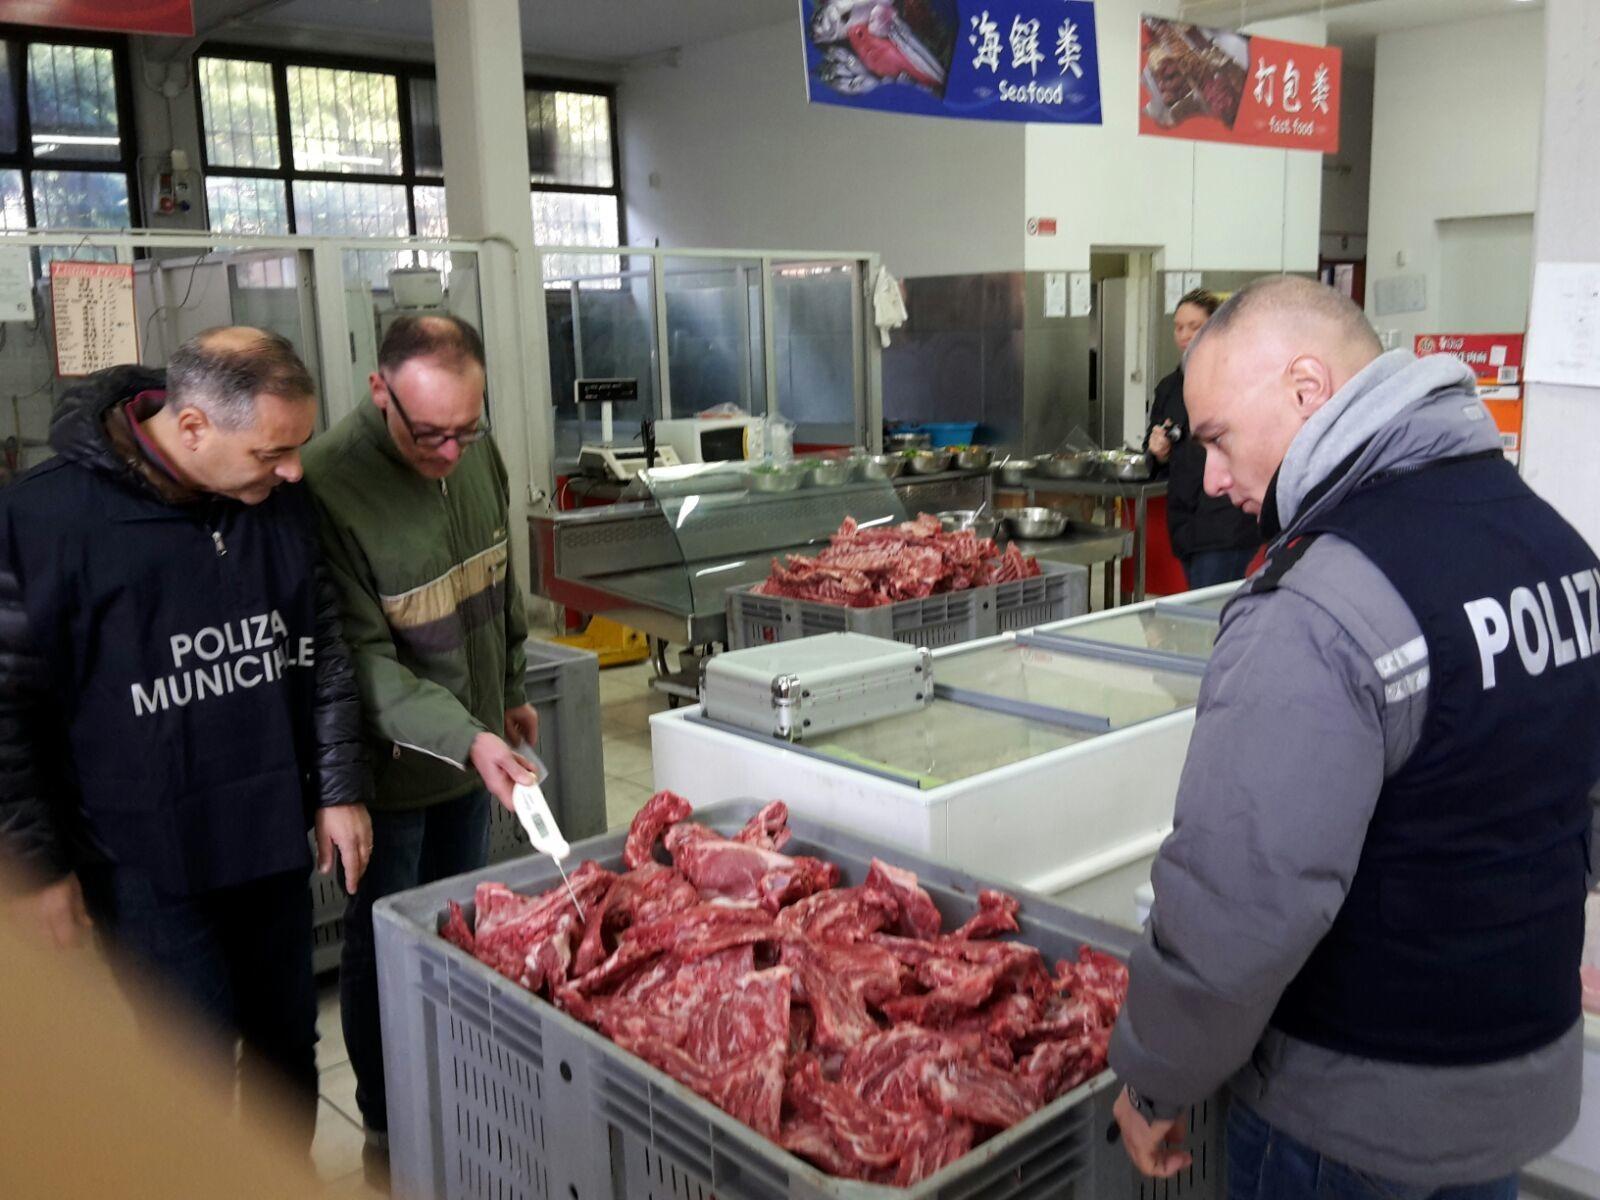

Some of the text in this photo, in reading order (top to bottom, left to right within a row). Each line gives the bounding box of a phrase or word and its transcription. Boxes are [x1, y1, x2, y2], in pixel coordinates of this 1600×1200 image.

[998, 80, 1063, 104] Seafood
[170, 609, 288, 669] POLIZA
[1463, 568, 1600, 691] POLIZ
